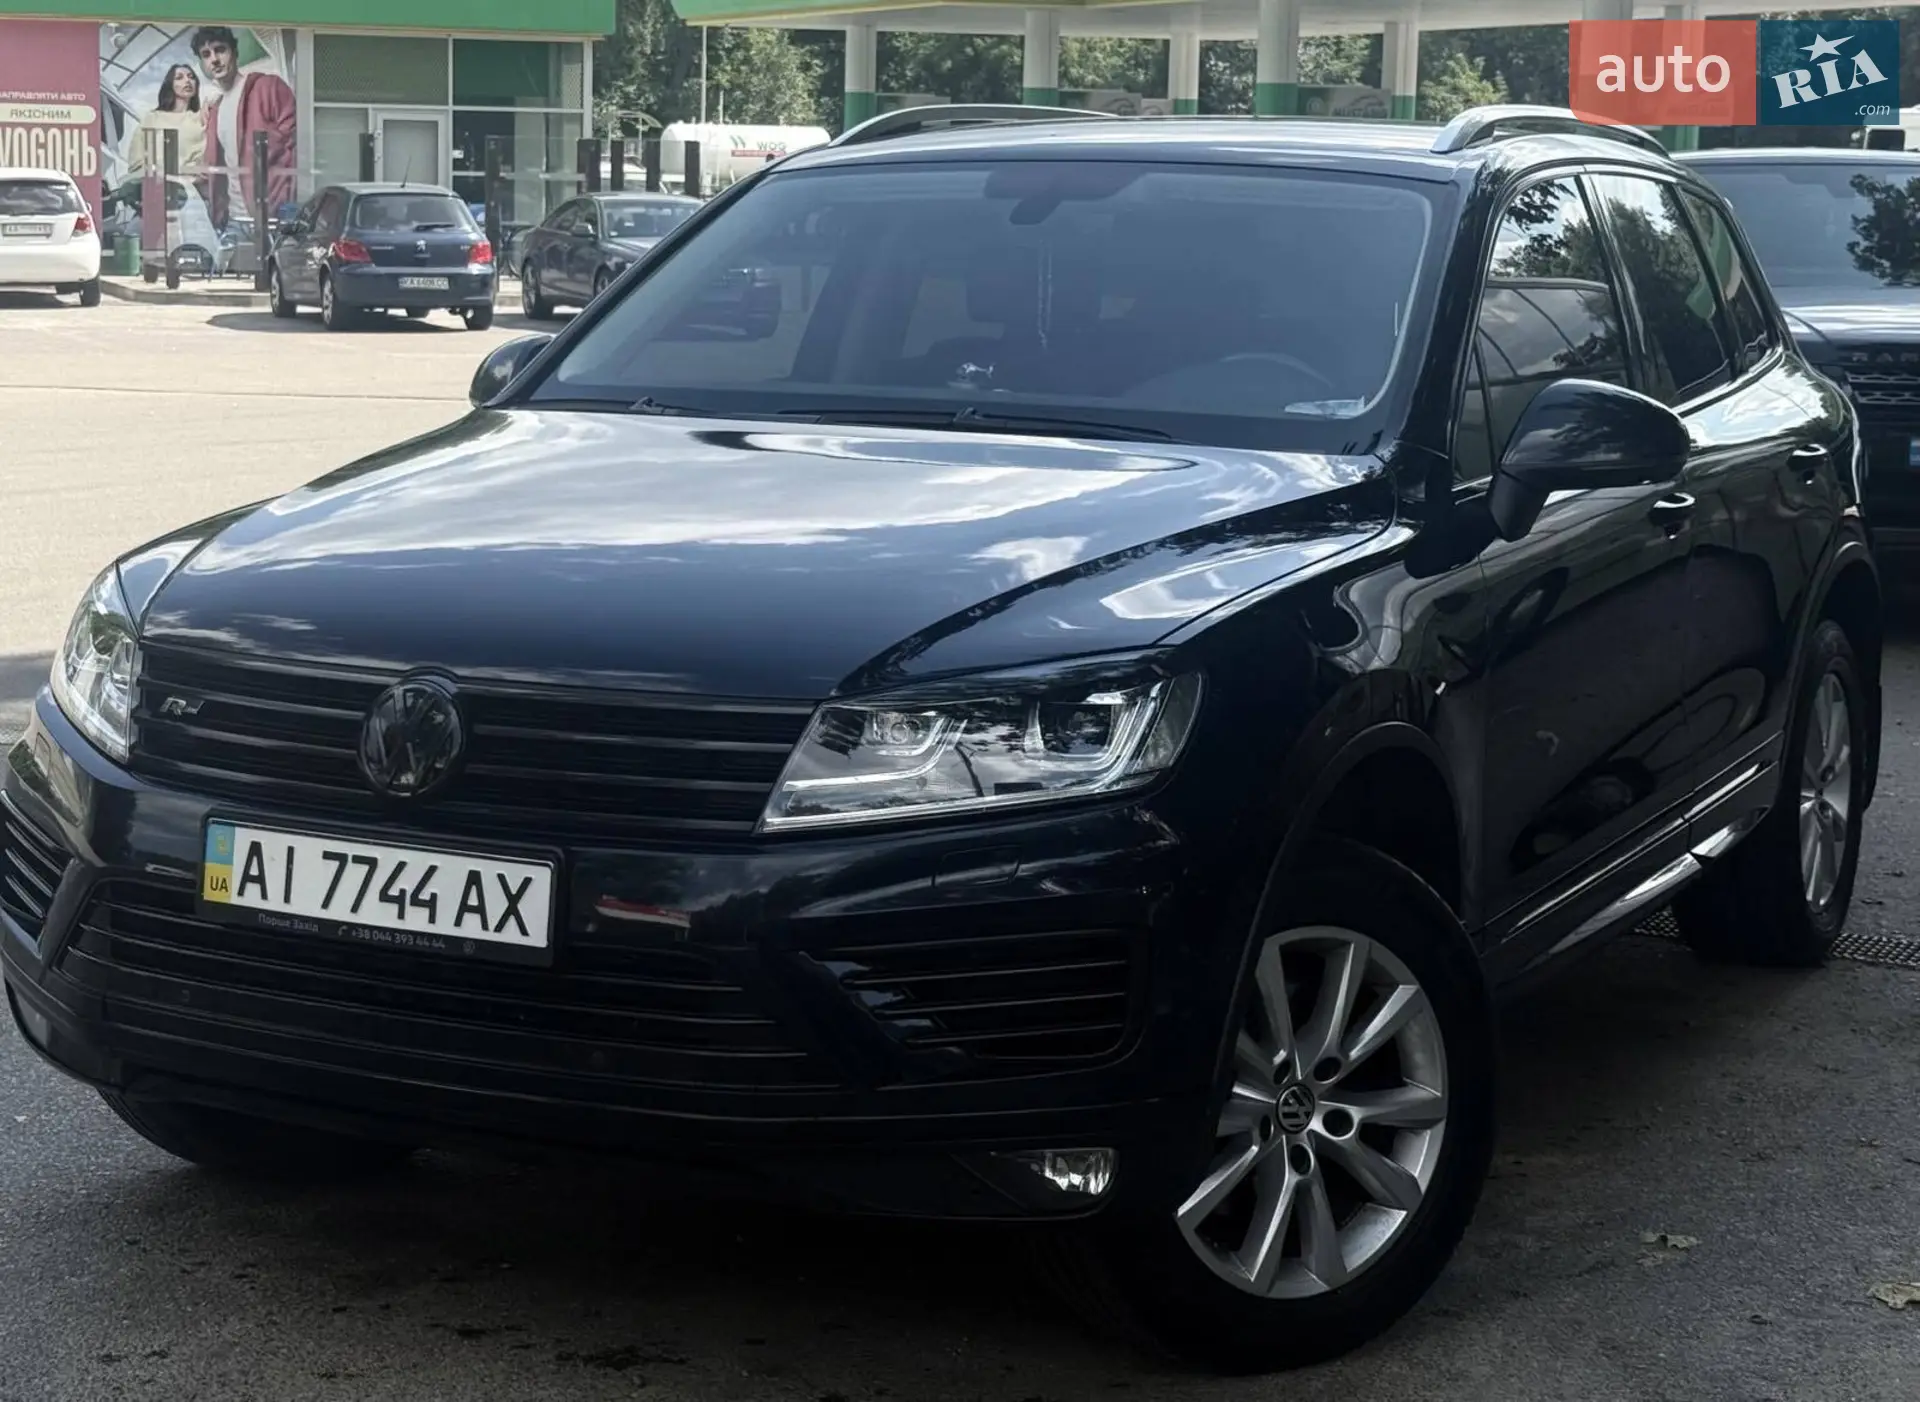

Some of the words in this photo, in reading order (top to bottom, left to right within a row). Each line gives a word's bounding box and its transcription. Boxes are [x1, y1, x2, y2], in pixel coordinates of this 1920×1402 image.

[0, 91, 58, 101] АПРАВЛЯТИ
[209, 876, 229, 893] UA
[237, 841, 295, 904] AI
[321, 850, 438, 924] 7744
[453, 869, 533, 937] AX
[394, 933, 414, 945] 393
